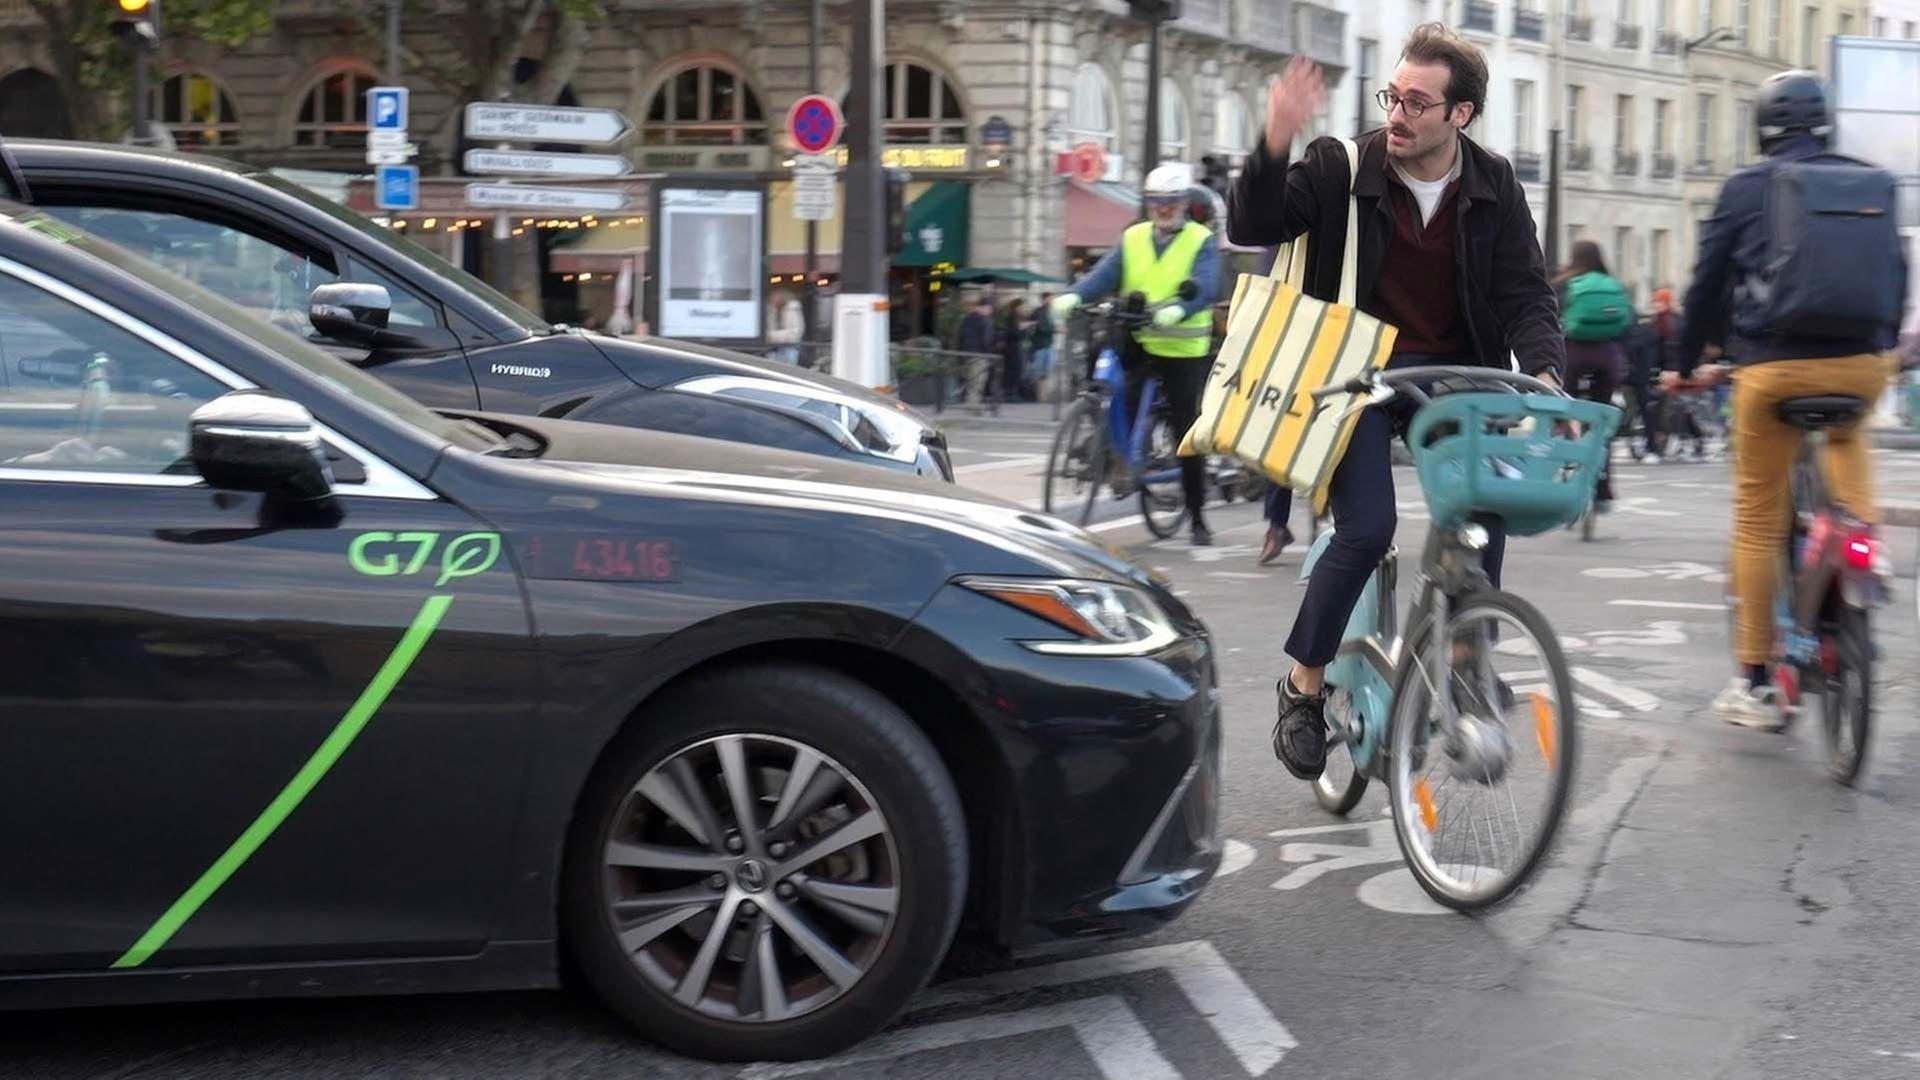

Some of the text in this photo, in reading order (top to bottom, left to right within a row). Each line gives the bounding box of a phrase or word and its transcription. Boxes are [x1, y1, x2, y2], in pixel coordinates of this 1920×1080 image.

[378, 95, 397, 122] P
[491, 363, 540, 377] HYBRID
[1210, 362, 1331, 422] FAIRLY
[348, 531, 440, 576] G7
[572, 540, 672, 578] 43416
